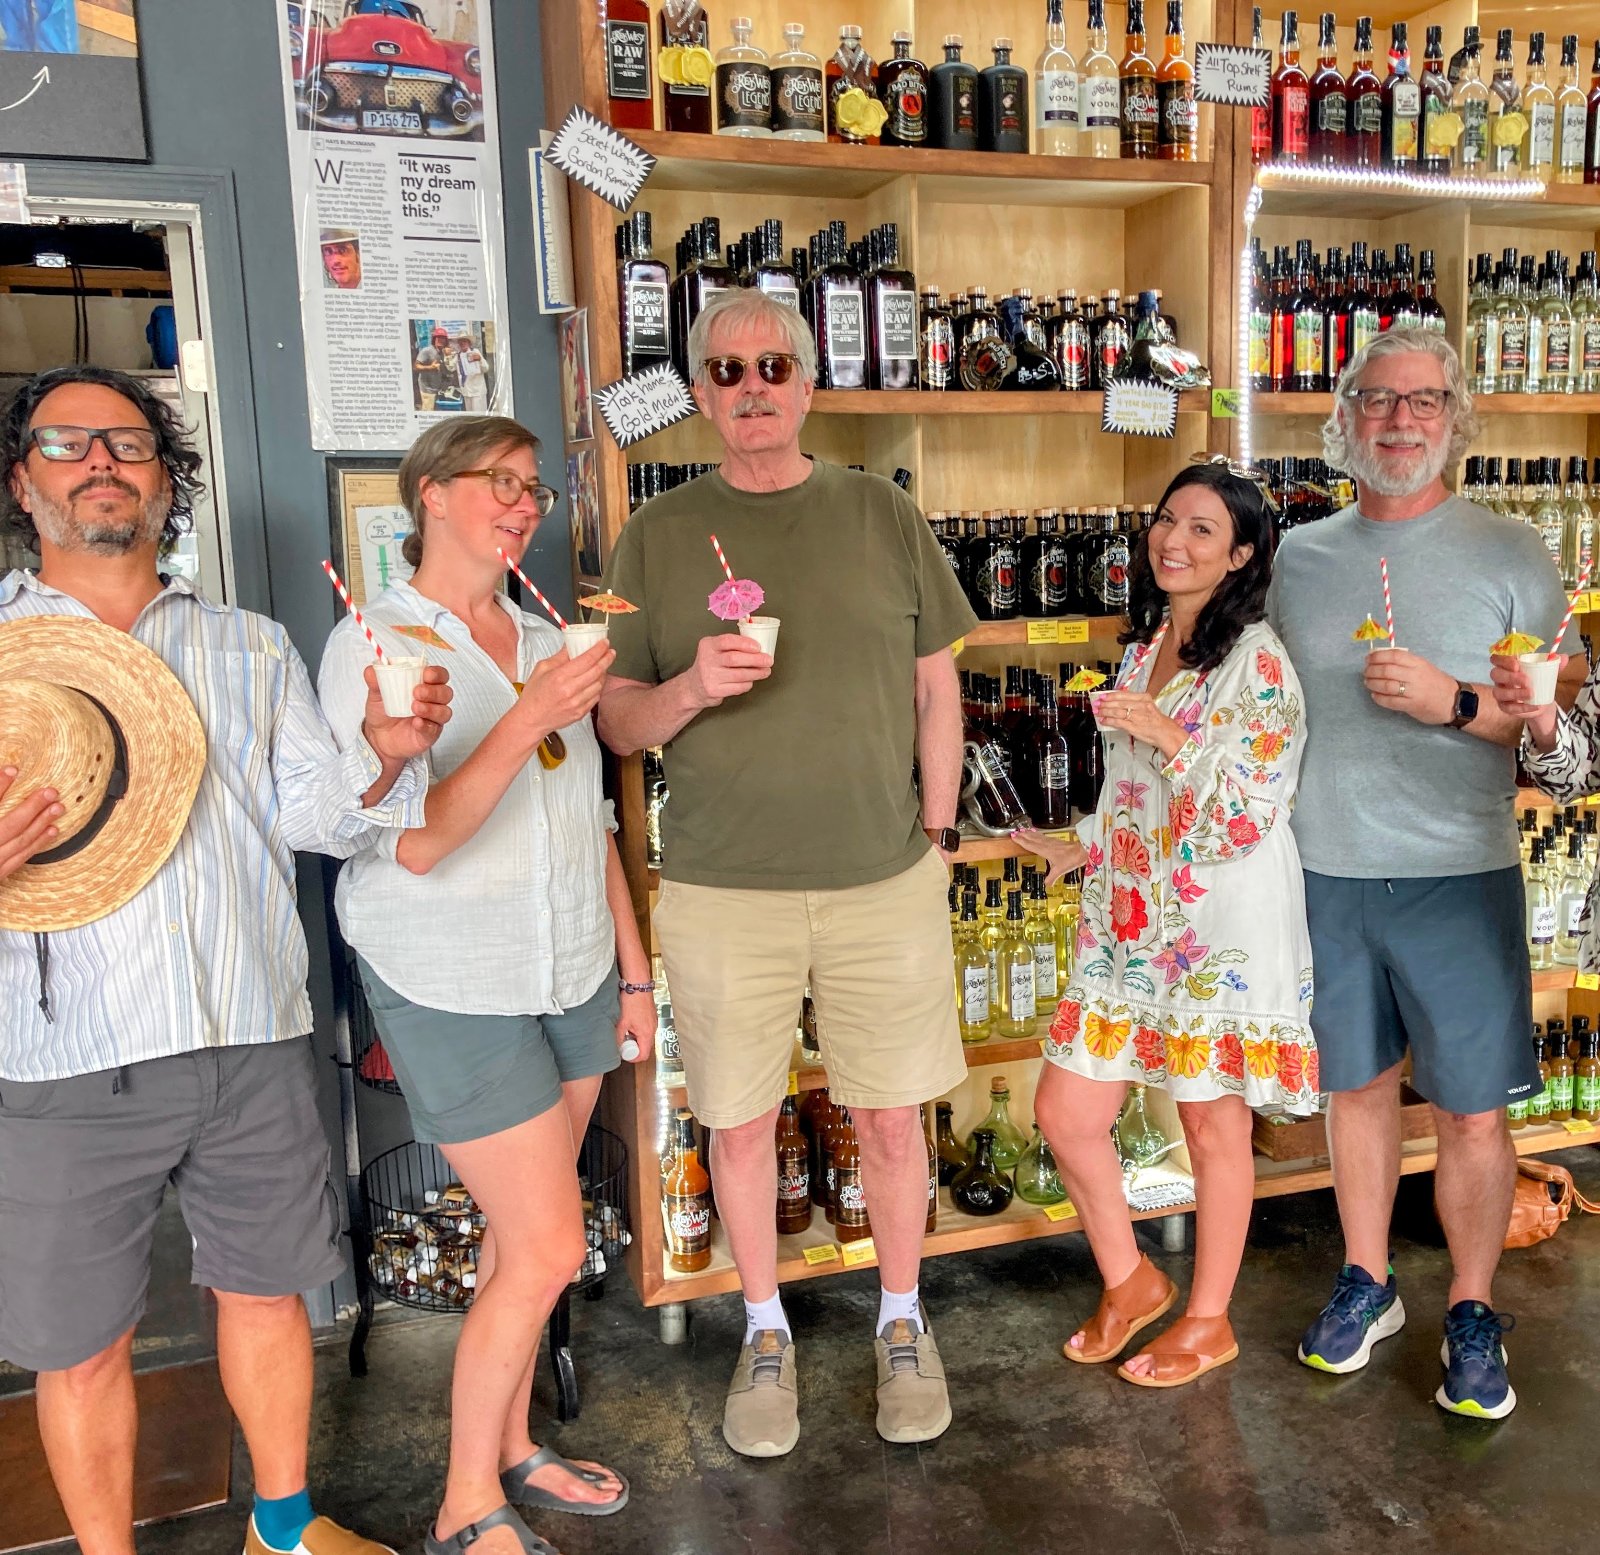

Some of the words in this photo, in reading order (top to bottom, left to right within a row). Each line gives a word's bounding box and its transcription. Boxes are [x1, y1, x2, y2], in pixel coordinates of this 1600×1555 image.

[614, 45, 643, 58] RAW
[1206, 56, 1219, 66] All
[1220, 58, 1240, 78] Top
[1241, 61, 1263, 77] Shelf
[892, 81, 908, 92] BAD
[908, 81, 927, 95] BITCH
[1227, 79, 1258, 94] Rums
[1049, 95, 1077, 103] VODKA
[370, 113, 377, 126] P
[379, 113, 399, 127] 156
[400, 115, 420, 128] 275
[577, 128, 609, 150] Secret
[567, 146, 603, 177] Gordon
[594, 152, 608, 163] on
[422, 162, 451, 174] was
[400, 177, 422, 190] my
[428, 176, 476, 191] dream
[402, 190, 417, 203] to
[422, 190, 441, 204] do
[634, 305, 662, 317] RAW
[832, 314, 858, 325] RAW
[885, 313, 911, 324] RAW
[607, 389, 638, 411] Took
[636, 376, 667, 395] home
[621, 407, 653, 433] Gold
[651, 388, 685, 413] Medal
[989, 558, 1004, 566] BAD
[1100, 555, 1115, 564] BAD
[778, 1175, 793, 1191] EY
